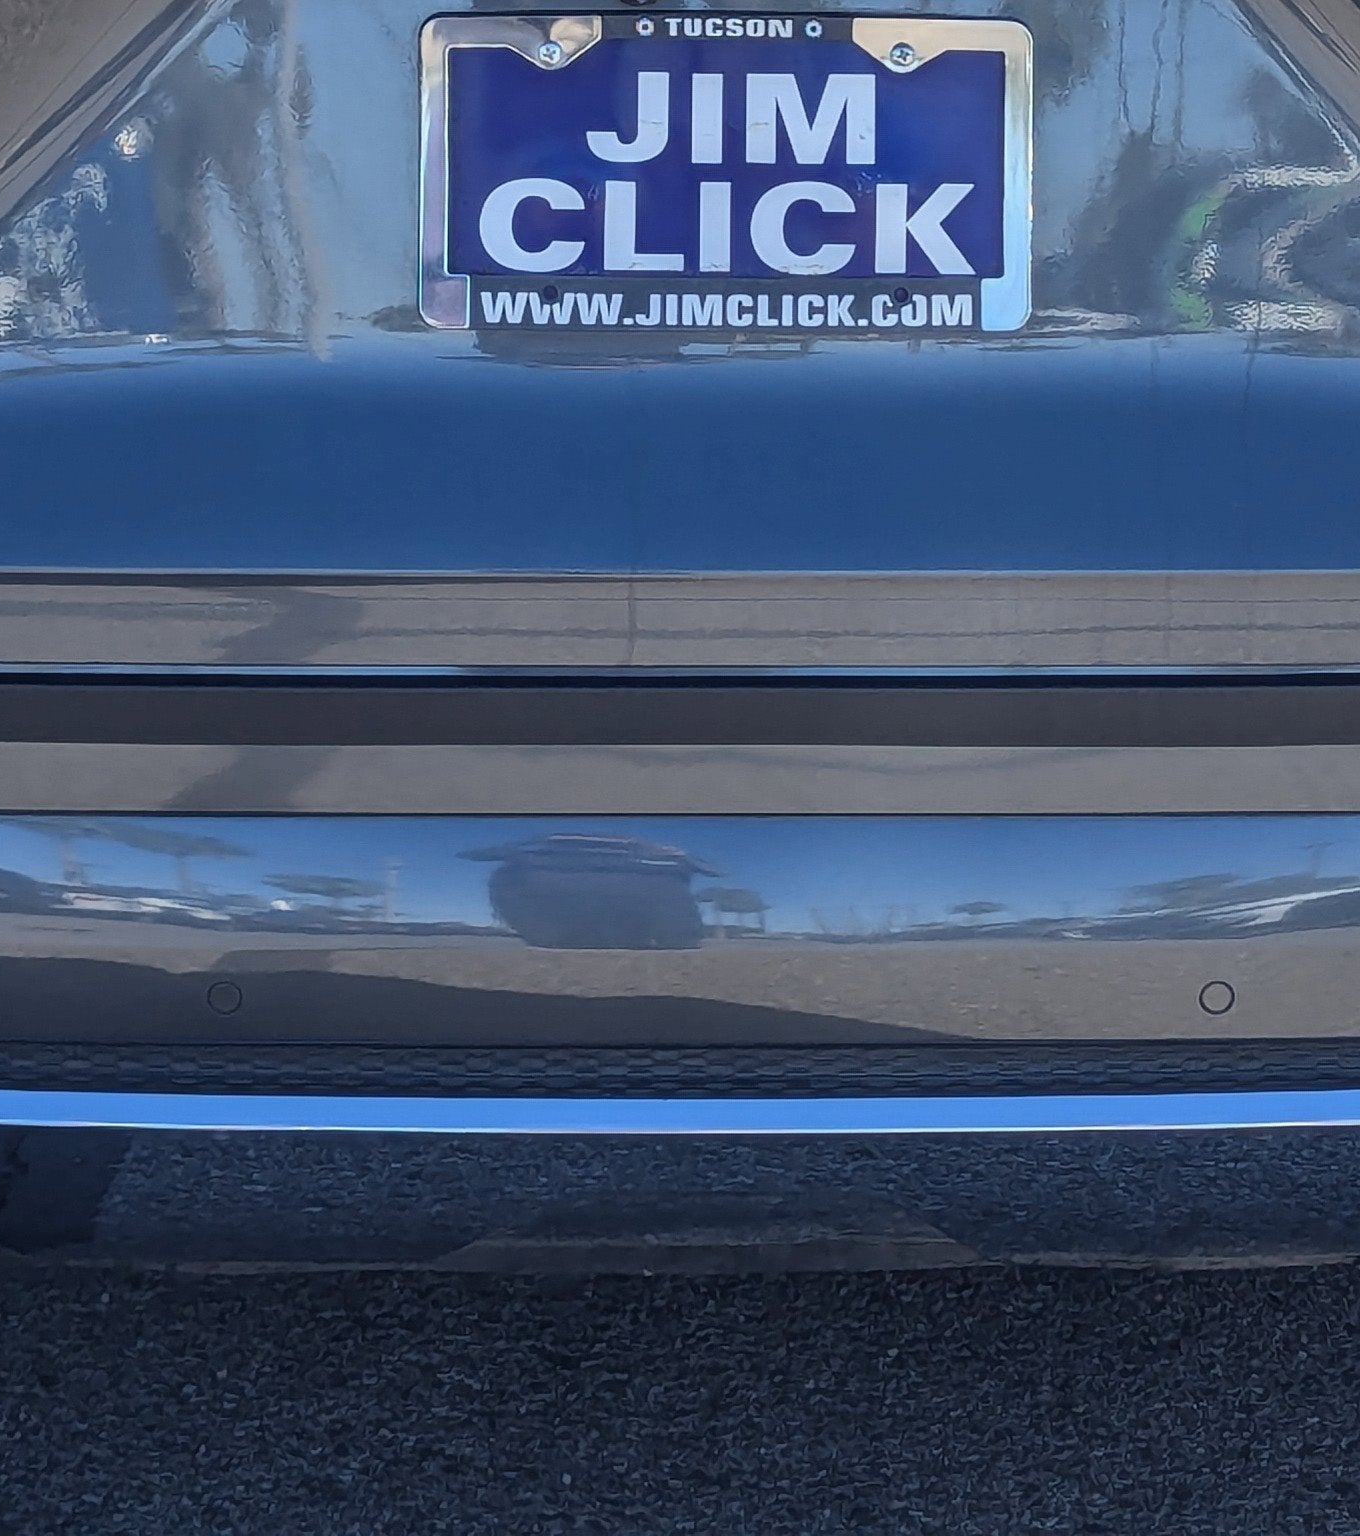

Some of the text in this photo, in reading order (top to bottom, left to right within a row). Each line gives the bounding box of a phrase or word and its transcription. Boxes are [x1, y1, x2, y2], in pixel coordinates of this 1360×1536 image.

[664, 17, 794, 38] TUCSON
[585, 71, 877, 165] JIM
[478, 177, 976, 276] CLICK
[480, 291, 974, 329] WWW.JIMCLICK.COM
